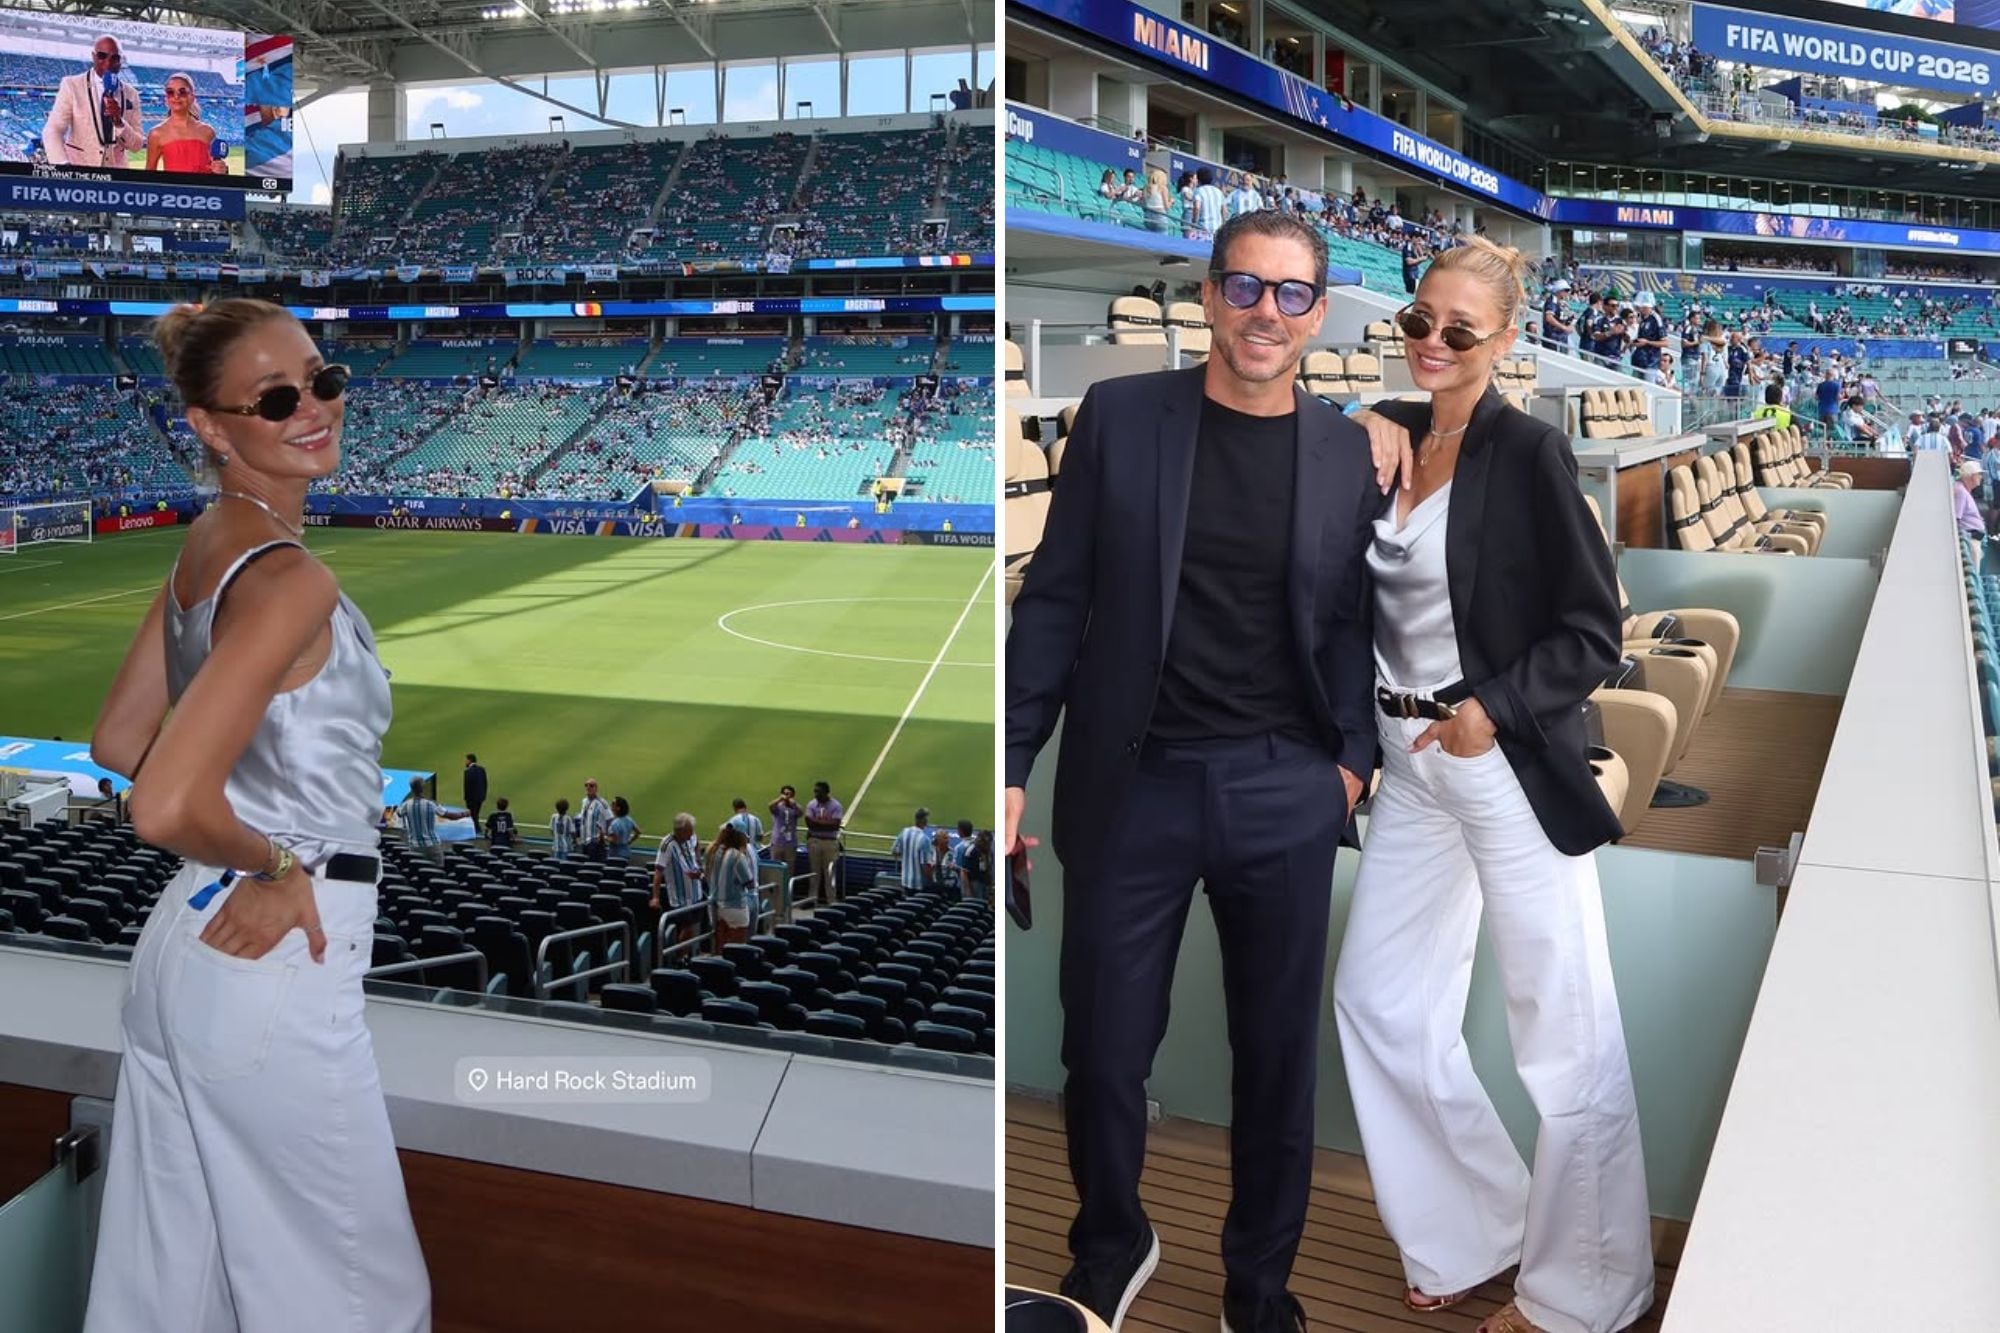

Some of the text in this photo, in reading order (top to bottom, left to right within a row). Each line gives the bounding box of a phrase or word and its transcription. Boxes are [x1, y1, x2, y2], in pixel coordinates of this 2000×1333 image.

[1134, 12, 1209, 72] MIAMI
[1726, 24, 1990, 86] FIFA WORLD CUP 2026
[1393, 130, 1499, 195] FIFA WORLD CUP 2026
[42, 170, 50, 178] IS
[51, 171, 73, 180] WHAT
[75, 172, 90, 180] THE
[91, 173, 112, 181] FANS
[12, 185, 223, 210] FIFA WORLD CUP 2026
[1617, 206, 1675, 225] MIAMI
[516, 267, 555, 281] ROCK
[18, 336, 64, 344] MIAMI
[442, 340, 482, 348] MIAMI
[963, 335, 985, 344] FIFA
[404, 499, 426, 509] FIFA
[119, 516, 154, 530] Lenovo
[375, 516, 482, 530] QATAR AIRWAYS
[549, 520, 587, 535] VISA
[628, 521, 666, 537] VISA
[47, 523, 83, 538] HYUNDAI
[933, 533, 995, 545] FIFA WORL
[497, 820, 507, 833] 10
